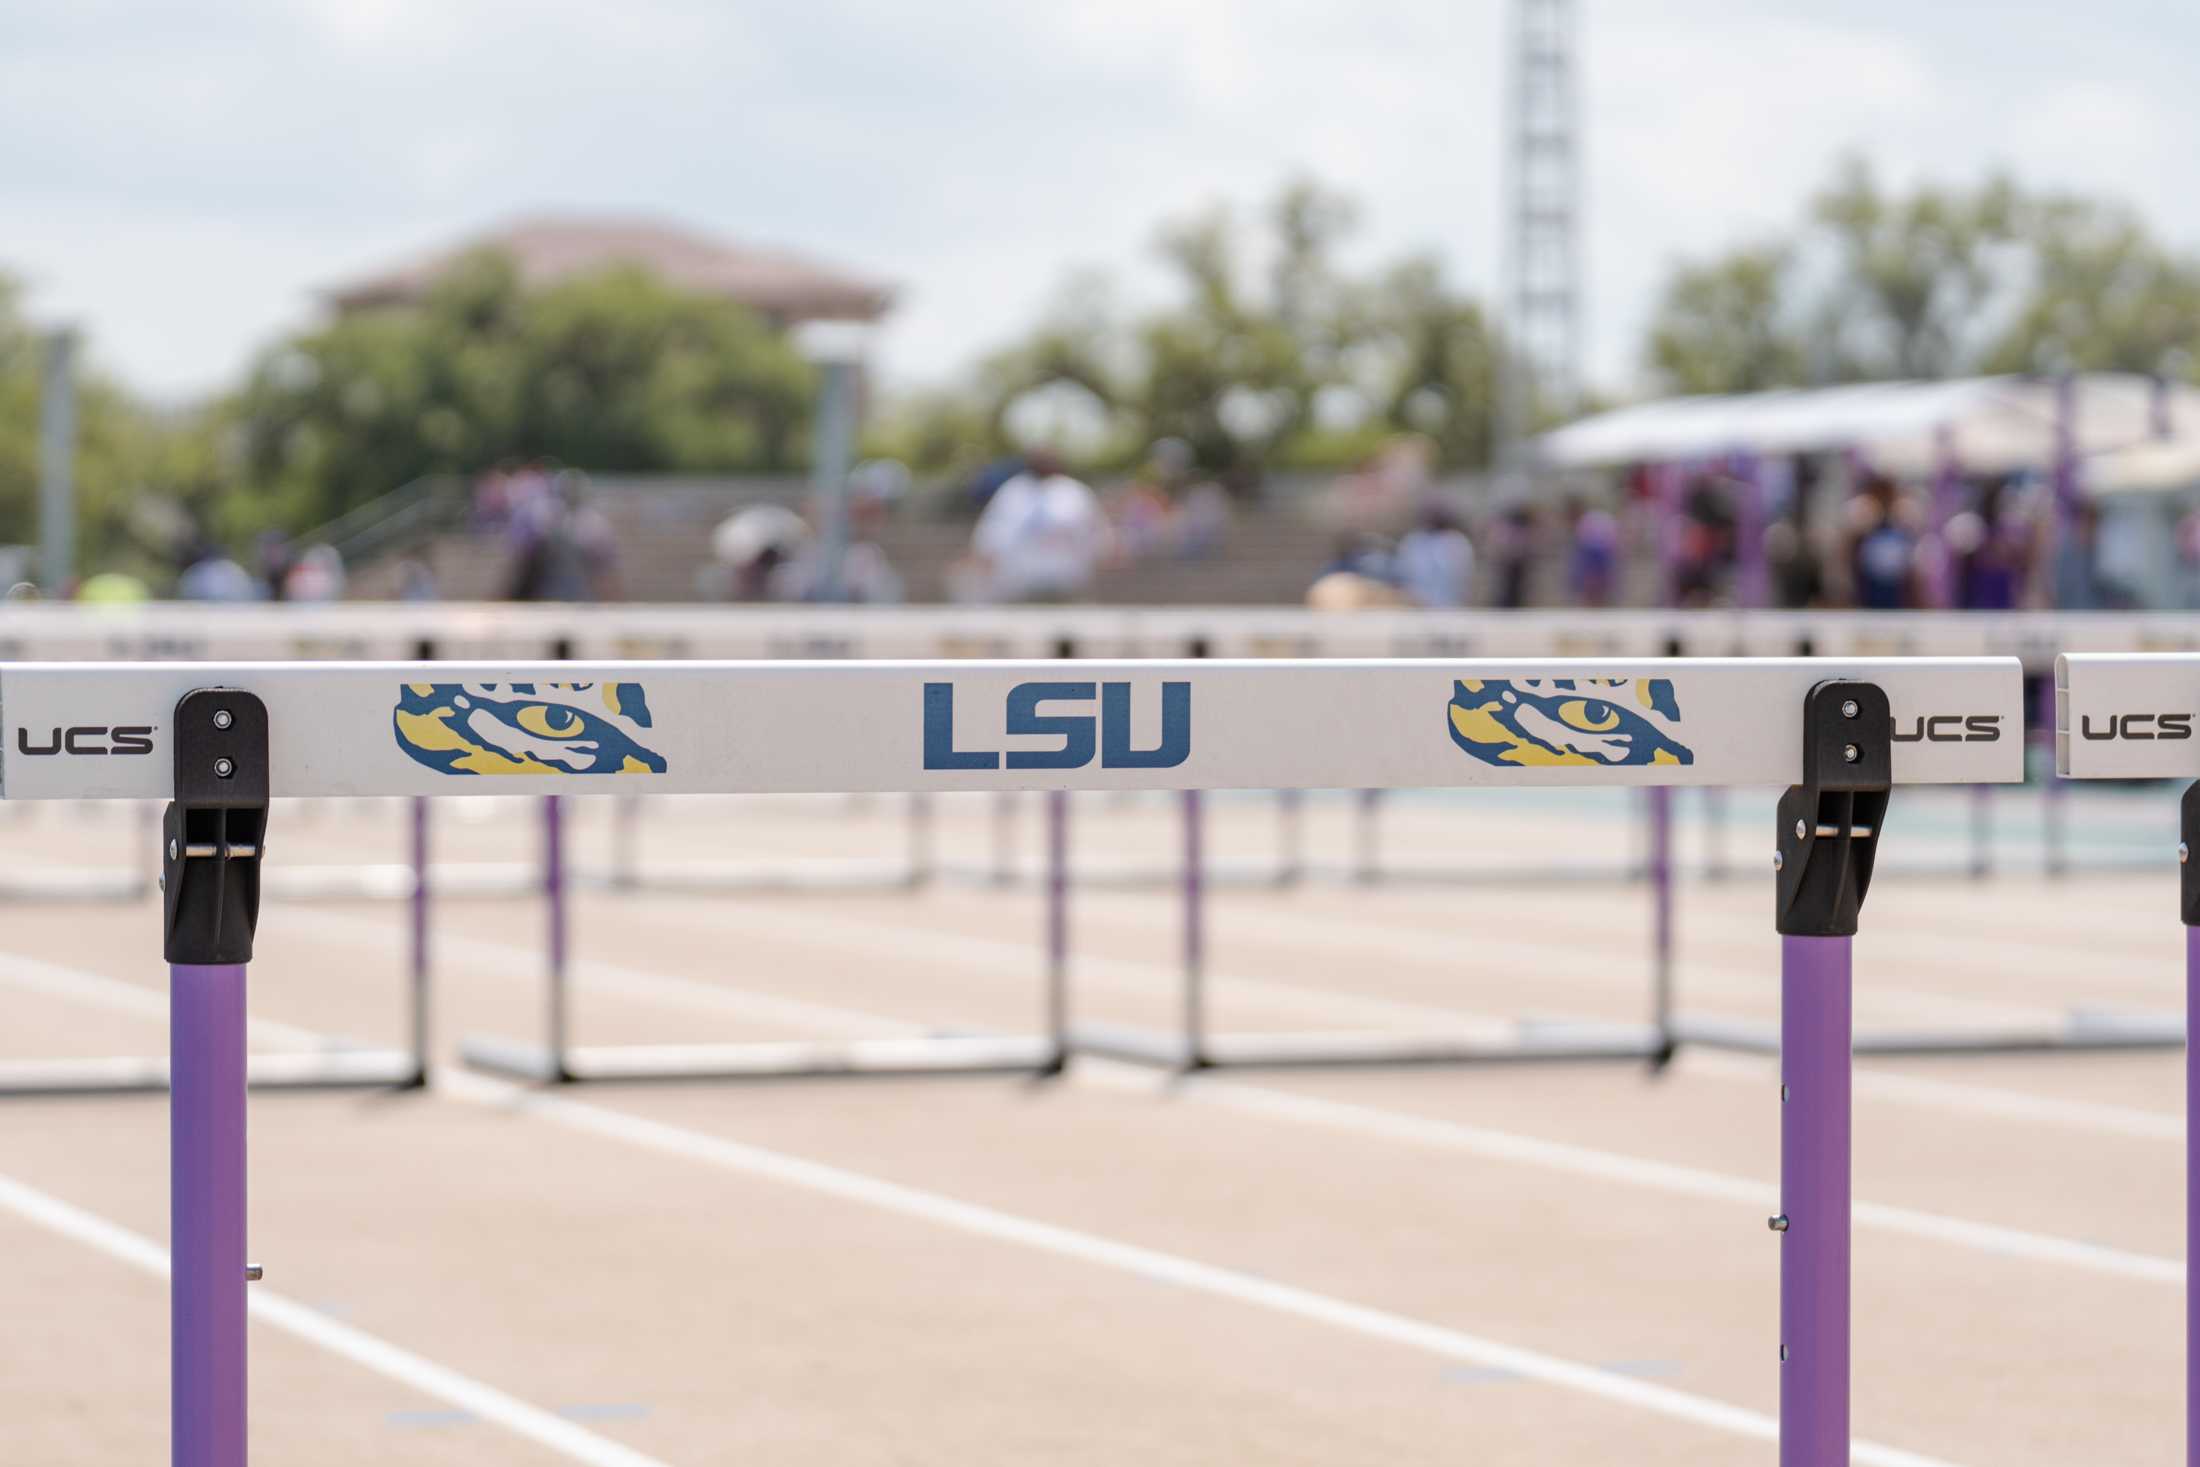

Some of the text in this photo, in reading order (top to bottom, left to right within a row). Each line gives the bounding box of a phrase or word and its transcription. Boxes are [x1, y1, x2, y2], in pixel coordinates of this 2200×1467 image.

[923, 682, 1191, 769] LSU
[1890, 715, 2001, 742] UCS
[2082, 714, 2192, 740] UCS
[18, 726, 154, 755] UCS
